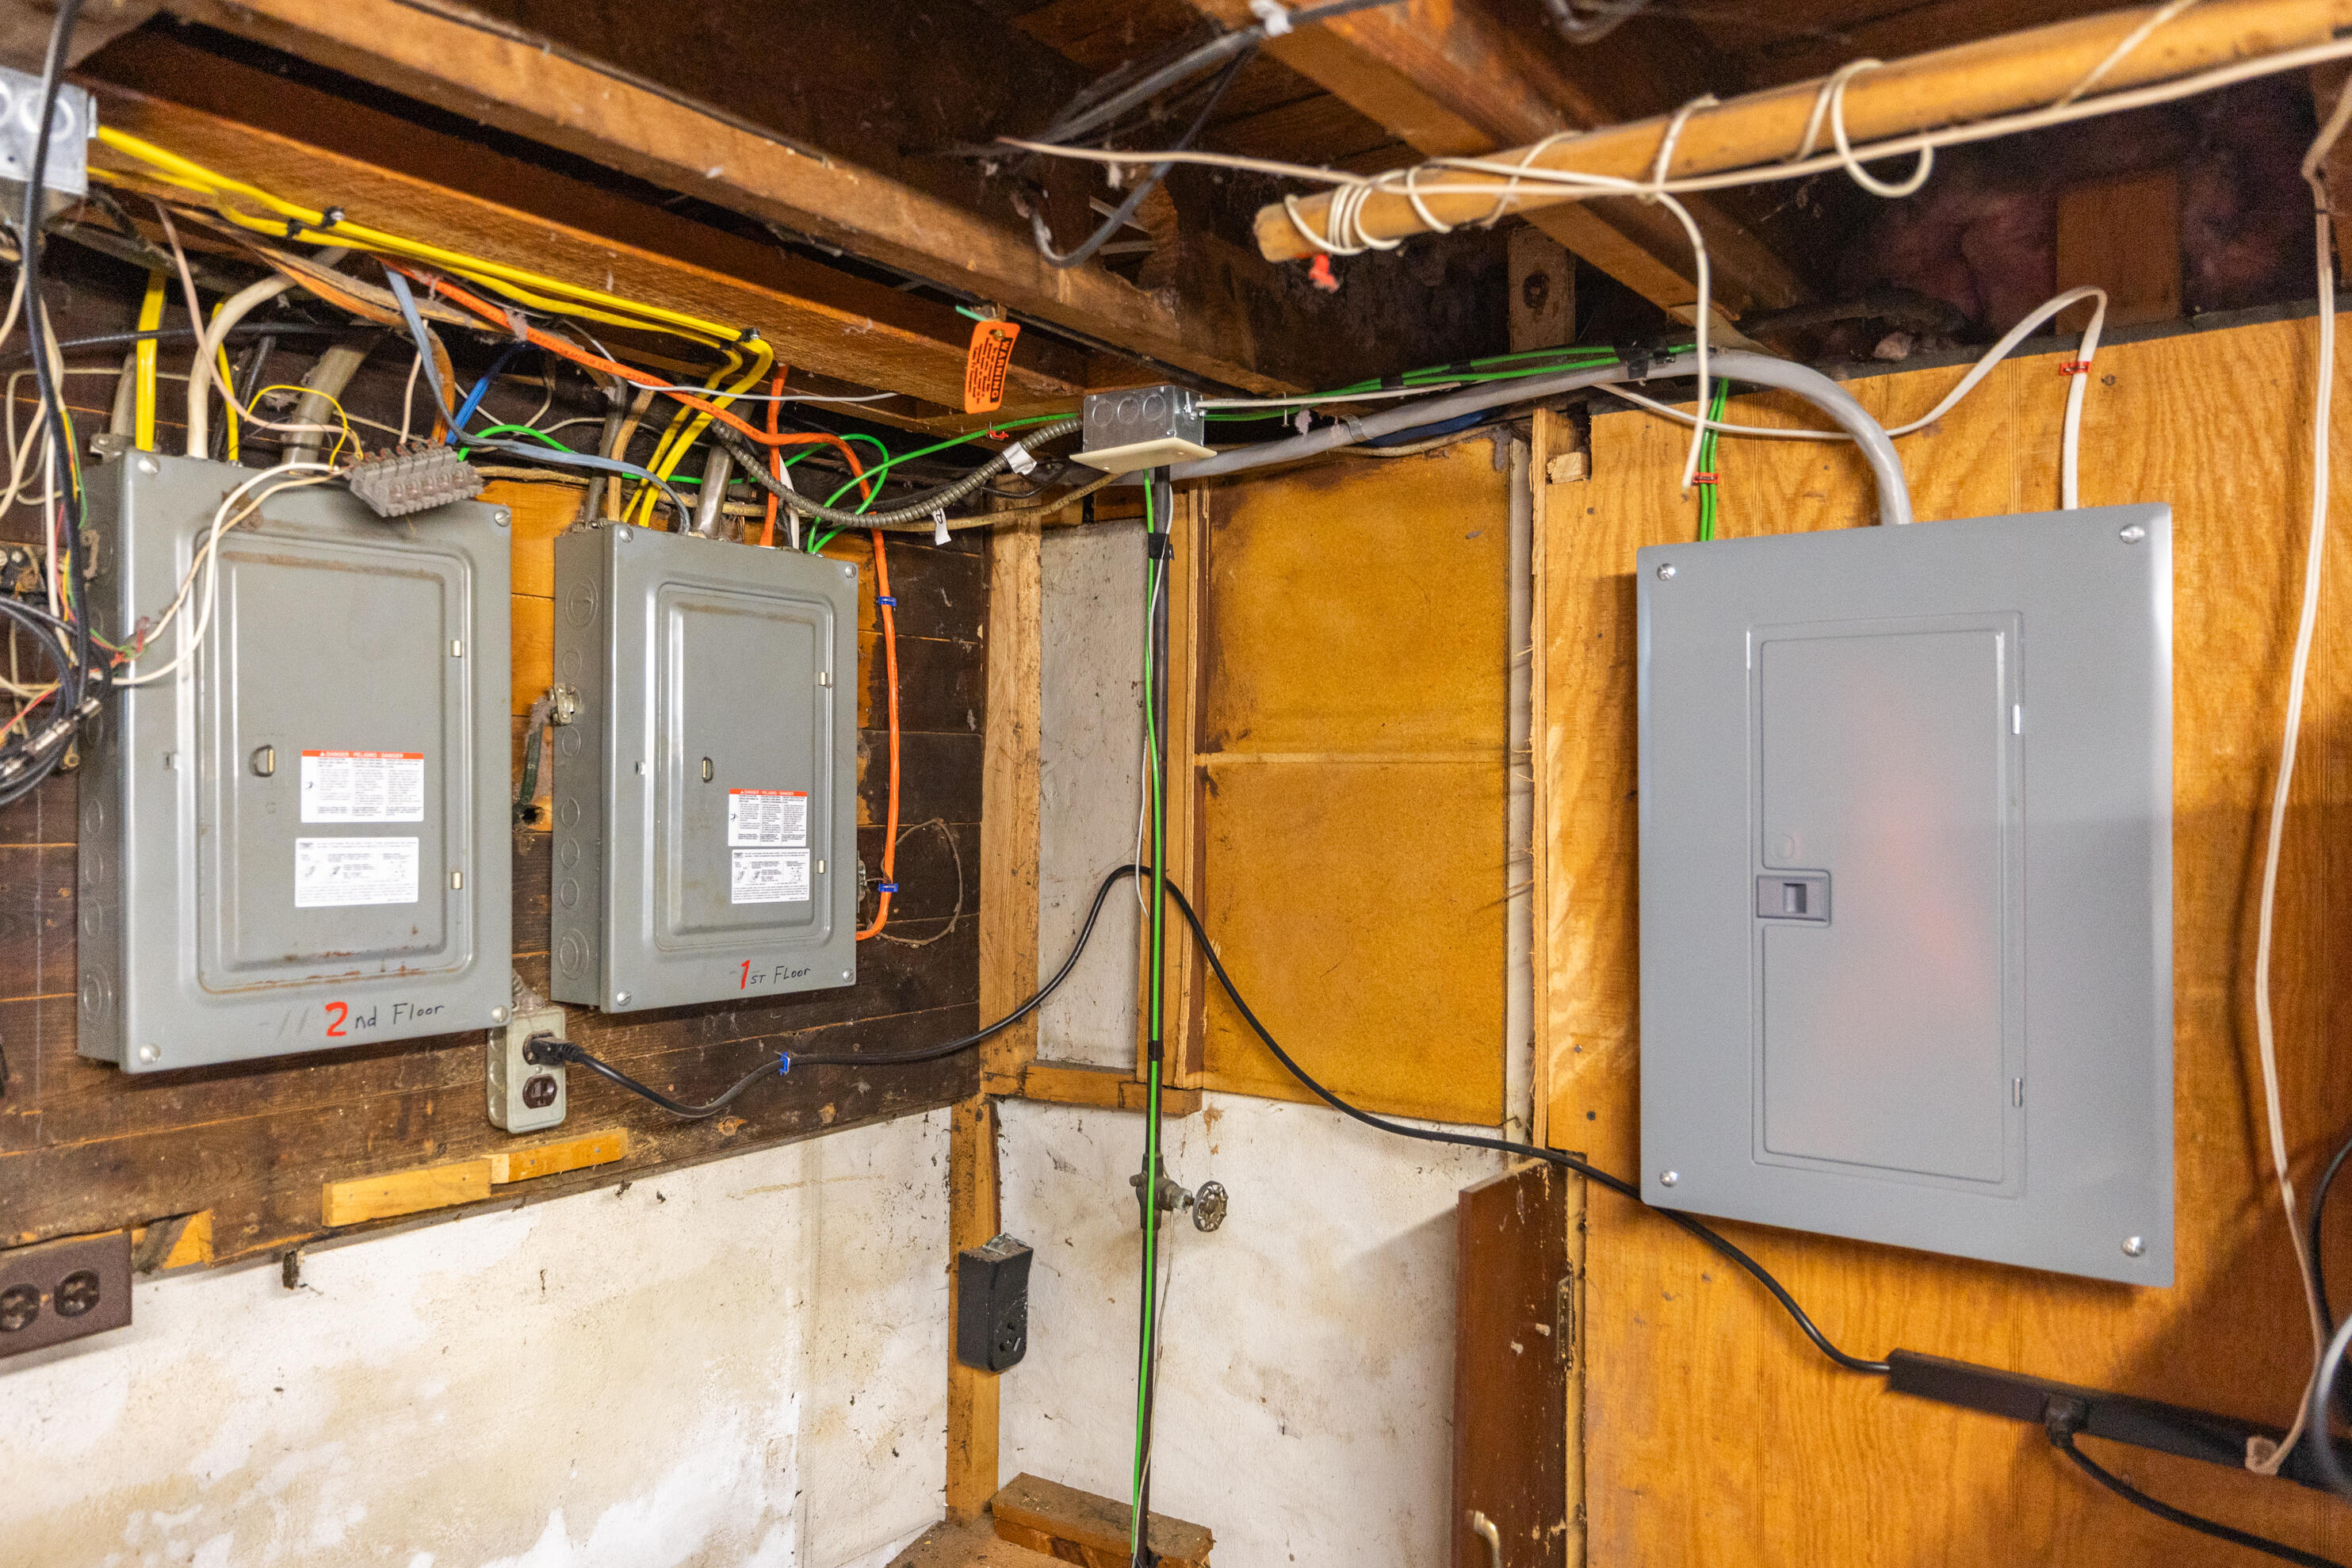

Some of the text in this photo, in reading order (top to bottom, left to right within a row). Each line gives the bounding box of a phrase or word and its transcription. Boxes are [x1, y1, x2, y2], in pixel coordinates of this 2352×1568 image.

[992, 341, 1009, 398] WARNING
[324, 1000, 445, 1038] 2nd Floor
